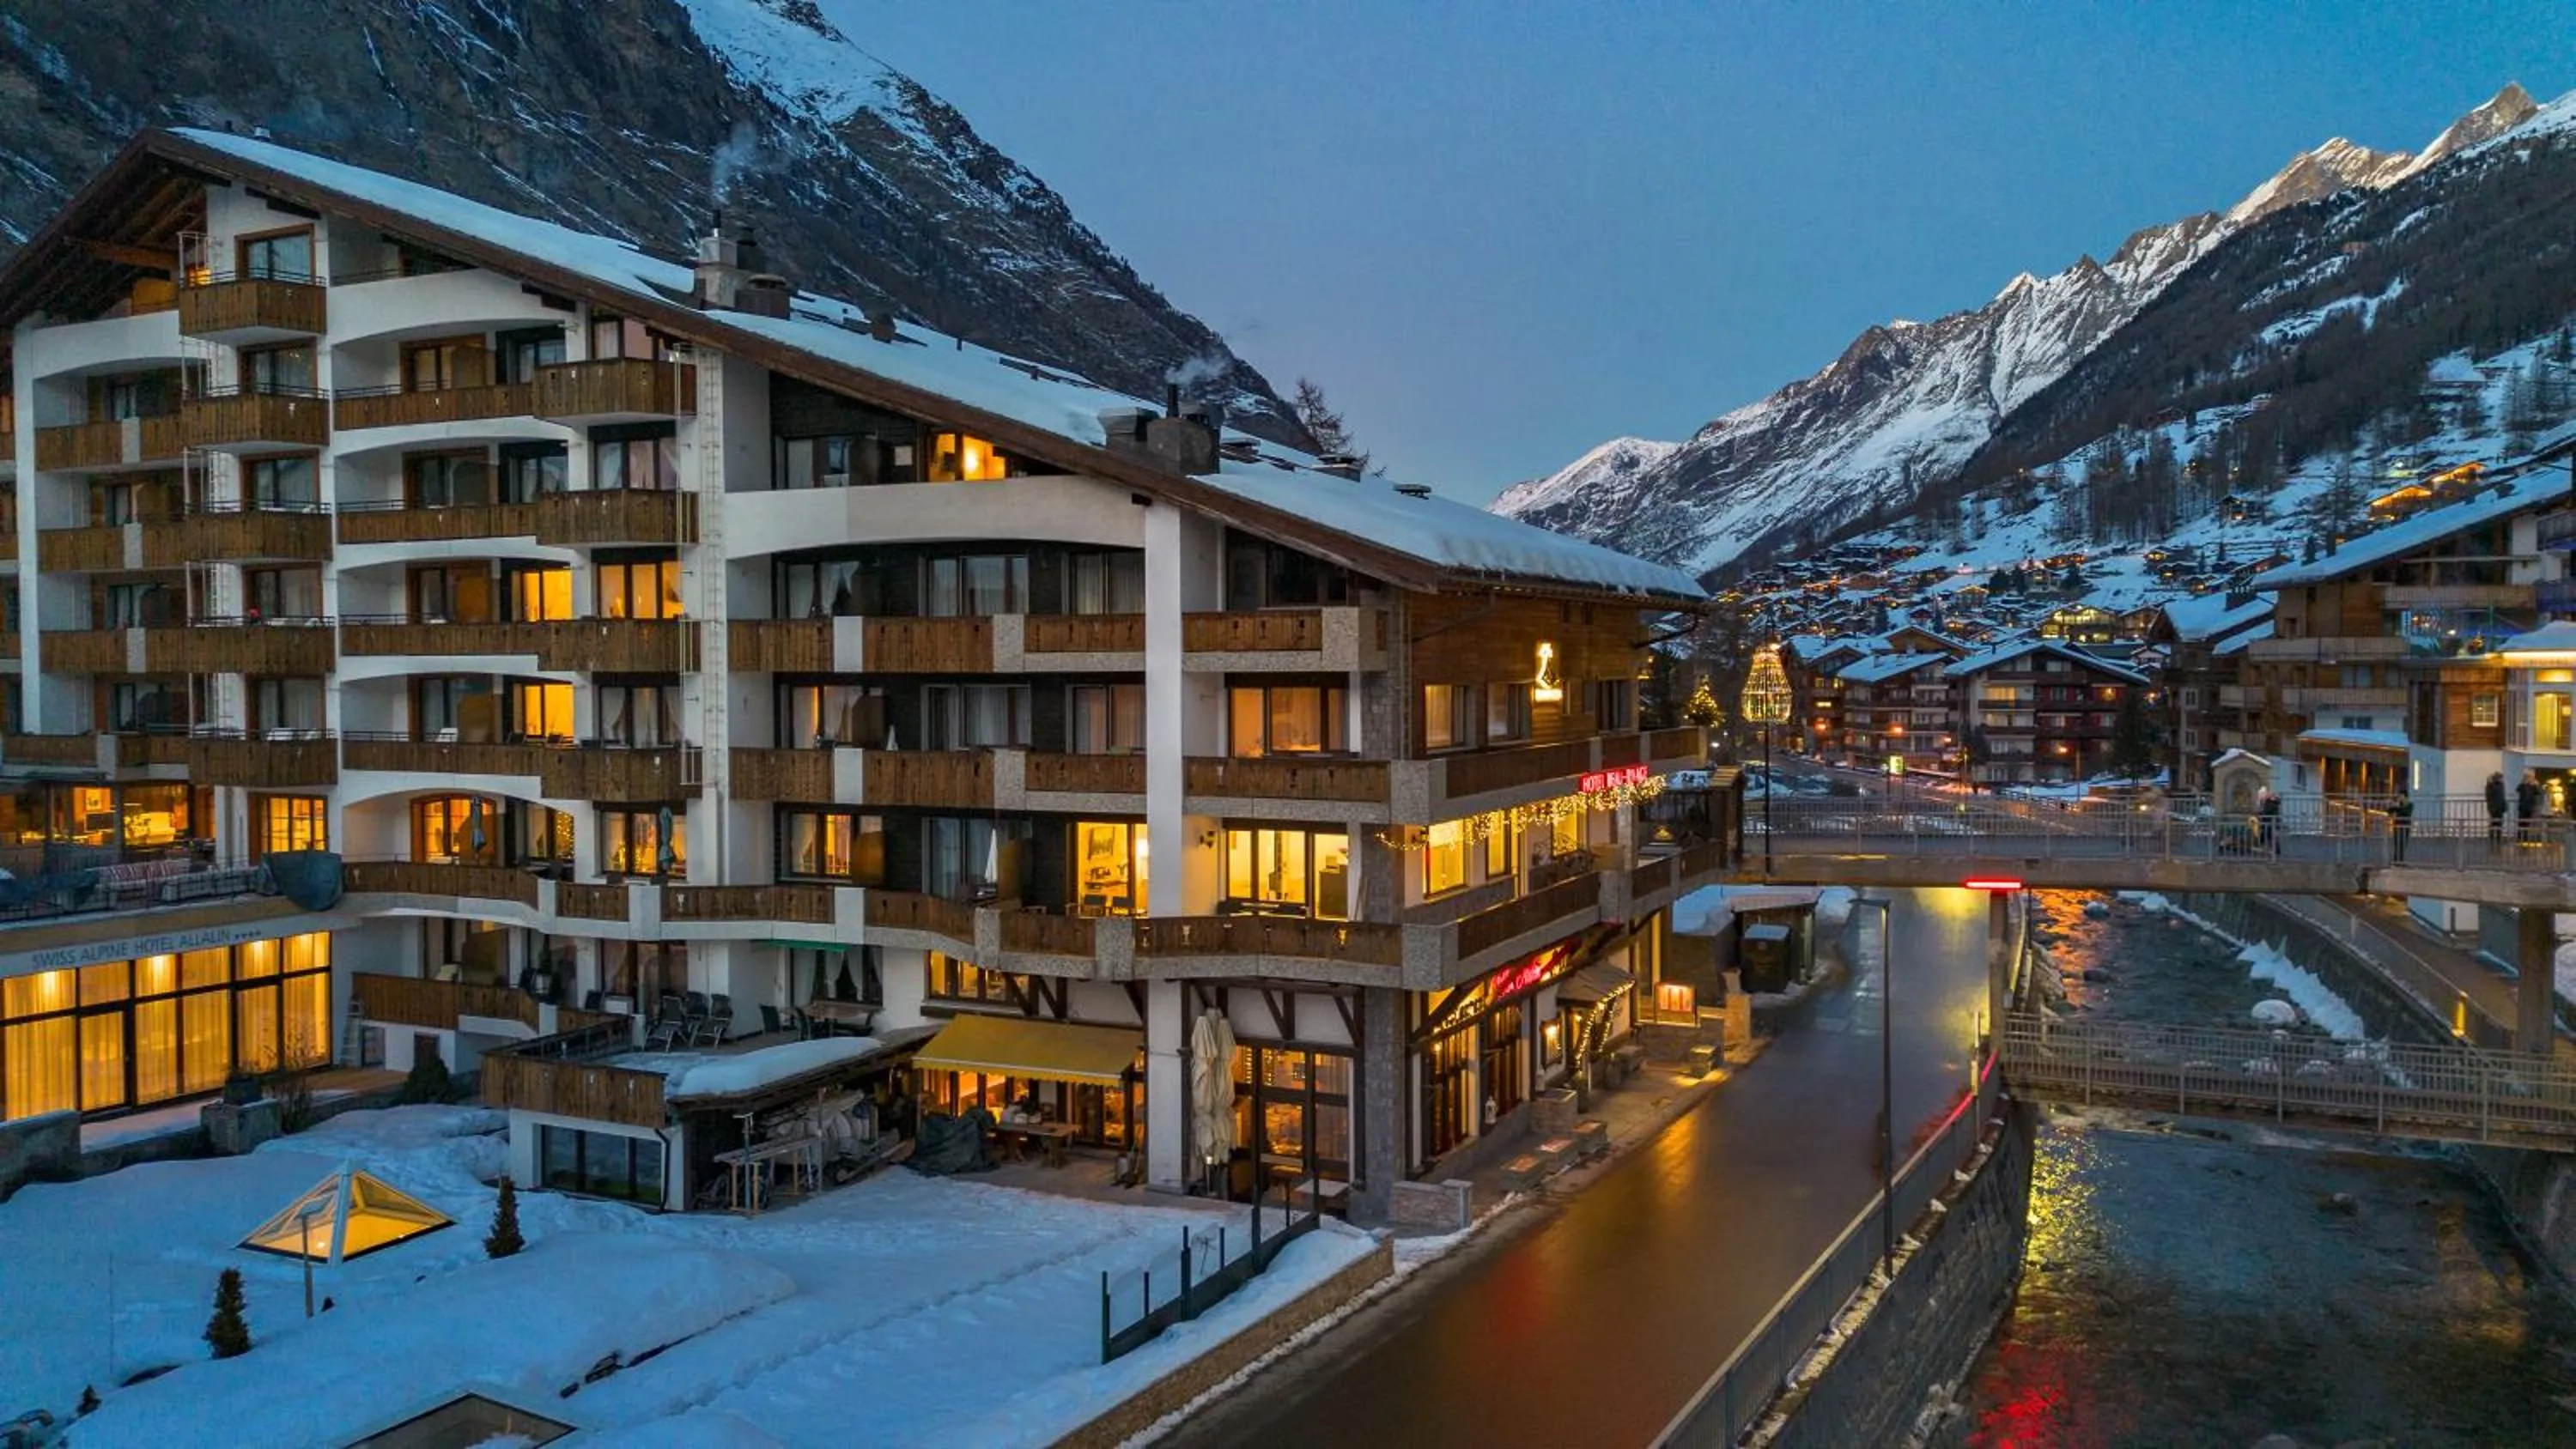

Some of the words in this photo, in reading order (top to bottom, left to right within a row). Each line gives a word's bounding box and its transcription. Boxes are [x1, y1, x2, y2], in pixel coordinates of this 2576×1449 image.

[1583, 773, 1605, 792] HOTEL
[32, 949, 76, 968] SWISS
[80, 943, 129, 961] ALPINE
[135, 937, 173, 953] HOTEL
[179, 929, 230, 949] ALLALIN
